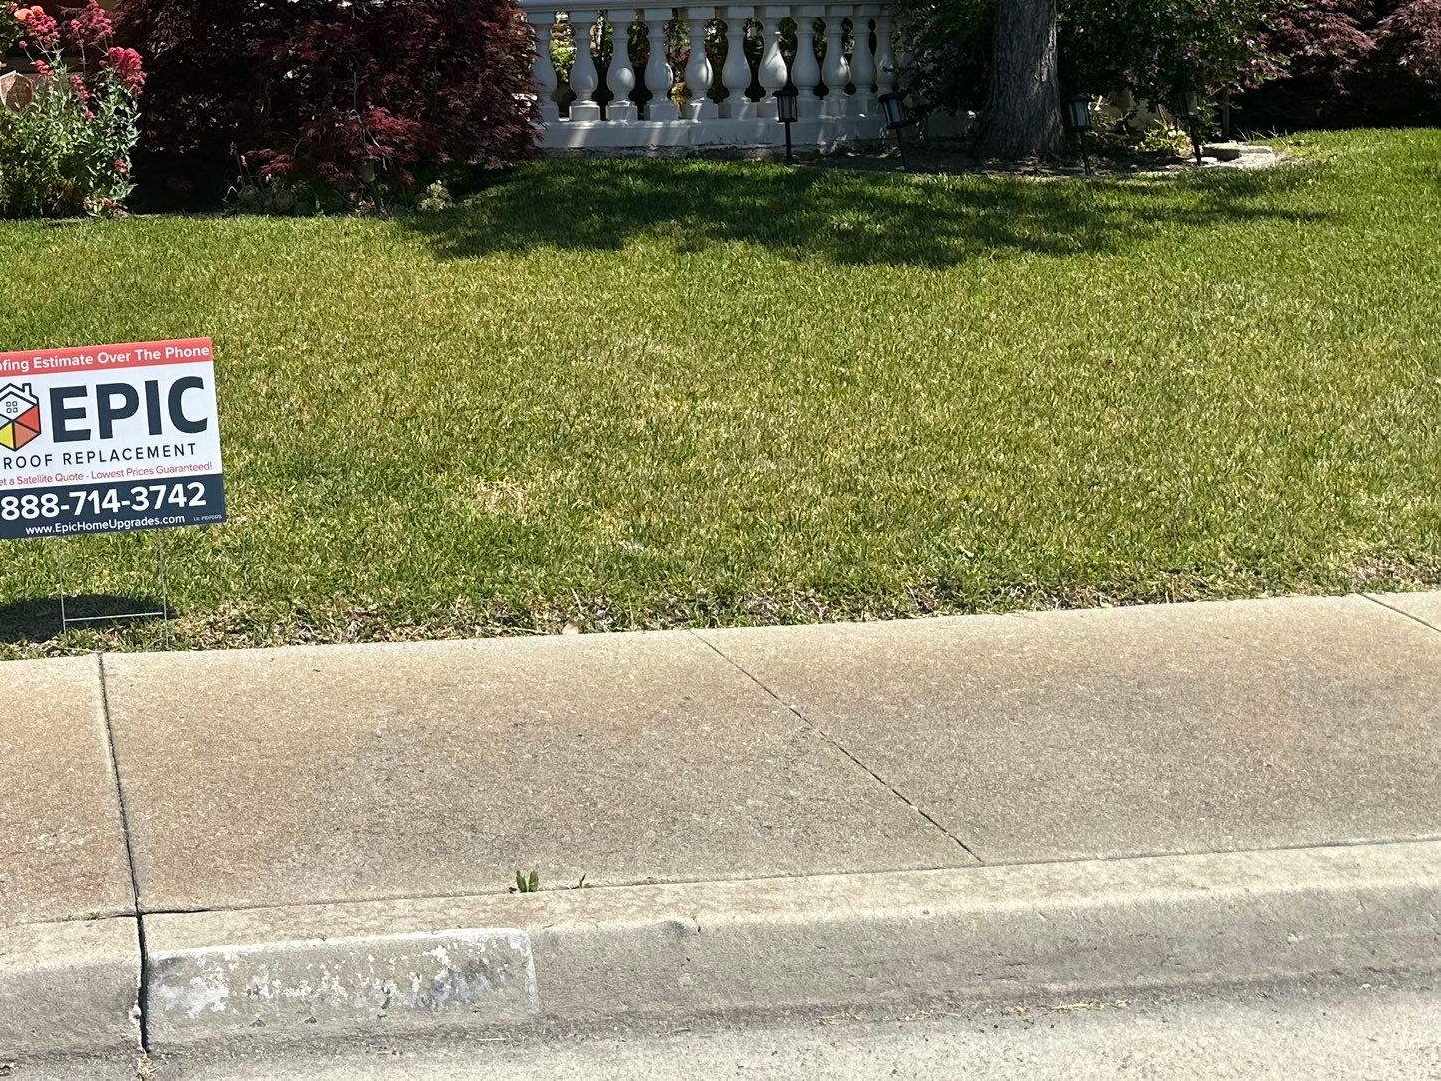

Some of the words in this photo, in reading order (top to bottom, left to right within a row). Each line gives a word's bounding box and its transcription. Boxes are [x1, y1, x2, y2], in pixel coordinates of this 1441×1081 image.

[33, 354, 94, 369] Estimate
[97, 351, 131, 364] Over
[134, 348, 161, 361] The
[164, 346, 210, 359] Phone
[49, 375, 208, 443] EPIC
[3, 453, 53, 470] ROOF
[62, 442, 196, 466] REPLACEMENT
[9, 478, 15, 486] a
[16, 473, 53, 485] Satellite
[54, 472, 84, 483] Quote
[91, 469, 125, 480] Lowest
[126, 466, 155, 477] Prices
[156, 460, 213, 475] Guaranteed!
[0, 481, 207, 521] 888-714-3742
[25, 514, 186, 535] www.EpicHomeUpgrades.com
